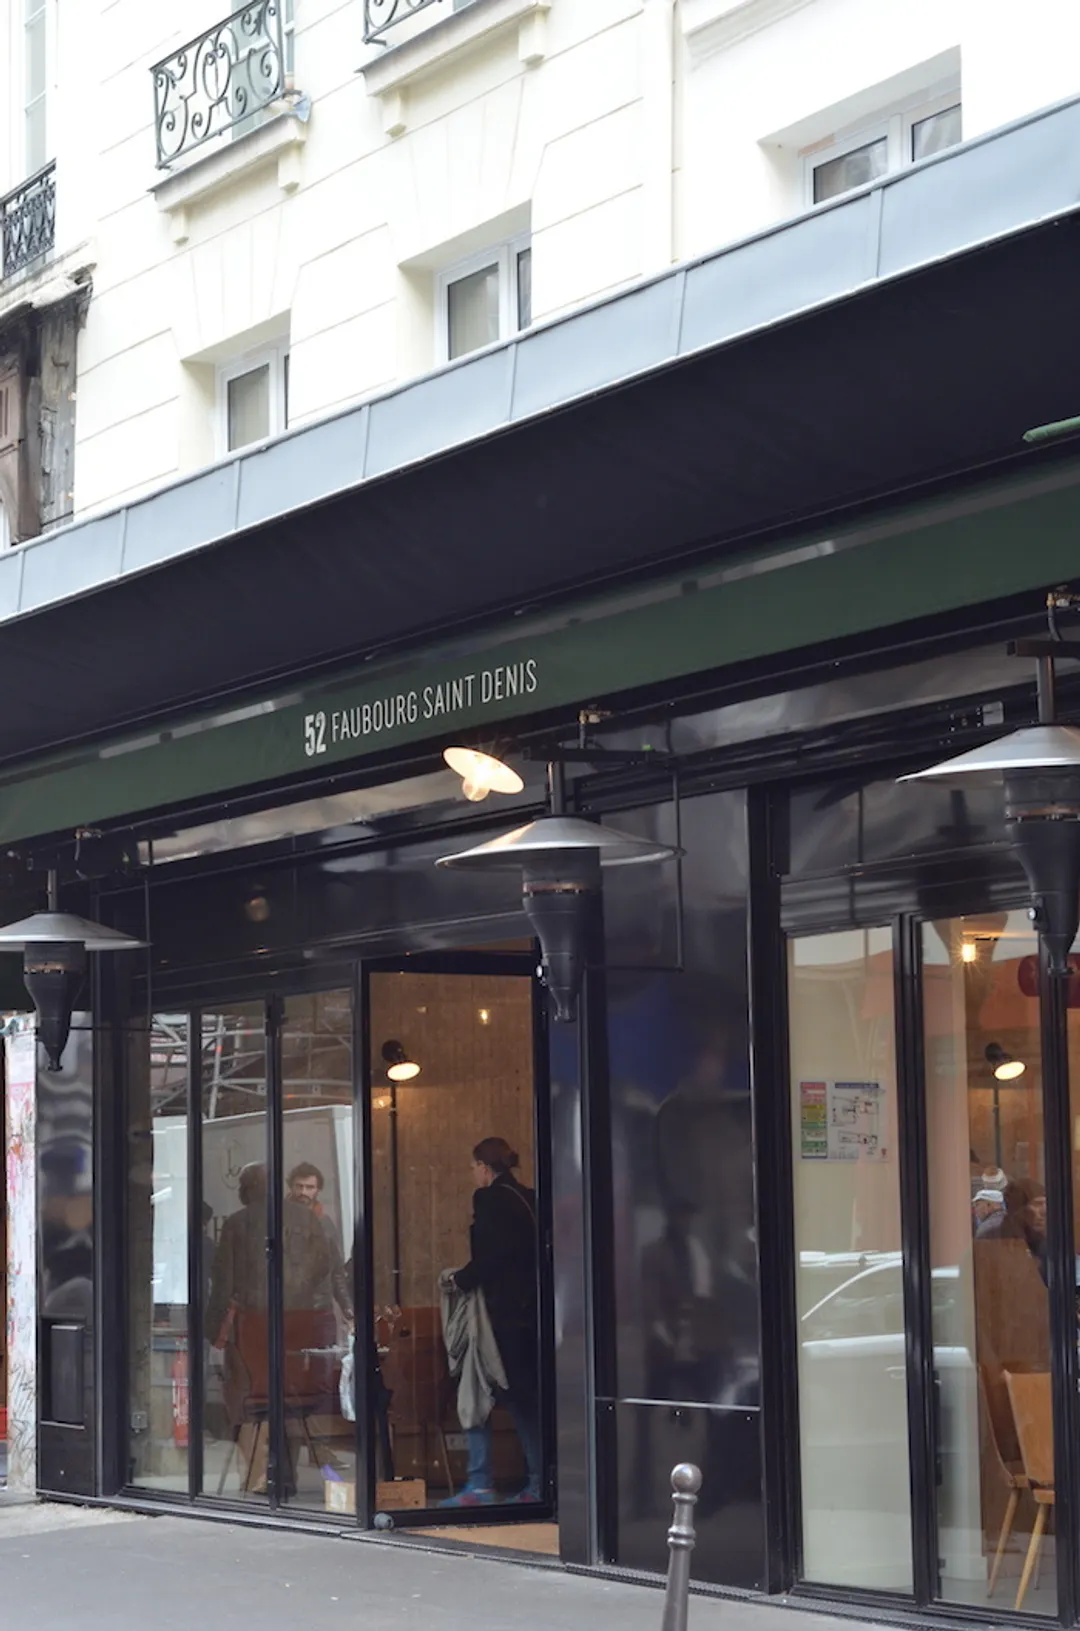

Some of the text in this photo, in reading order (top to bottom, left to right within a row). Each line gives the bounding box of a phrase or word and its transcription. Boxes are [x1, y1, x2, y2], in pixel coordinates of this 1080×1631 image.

[304, 658, 538, 757] 52 FAUBOURG SAINT DENIS
